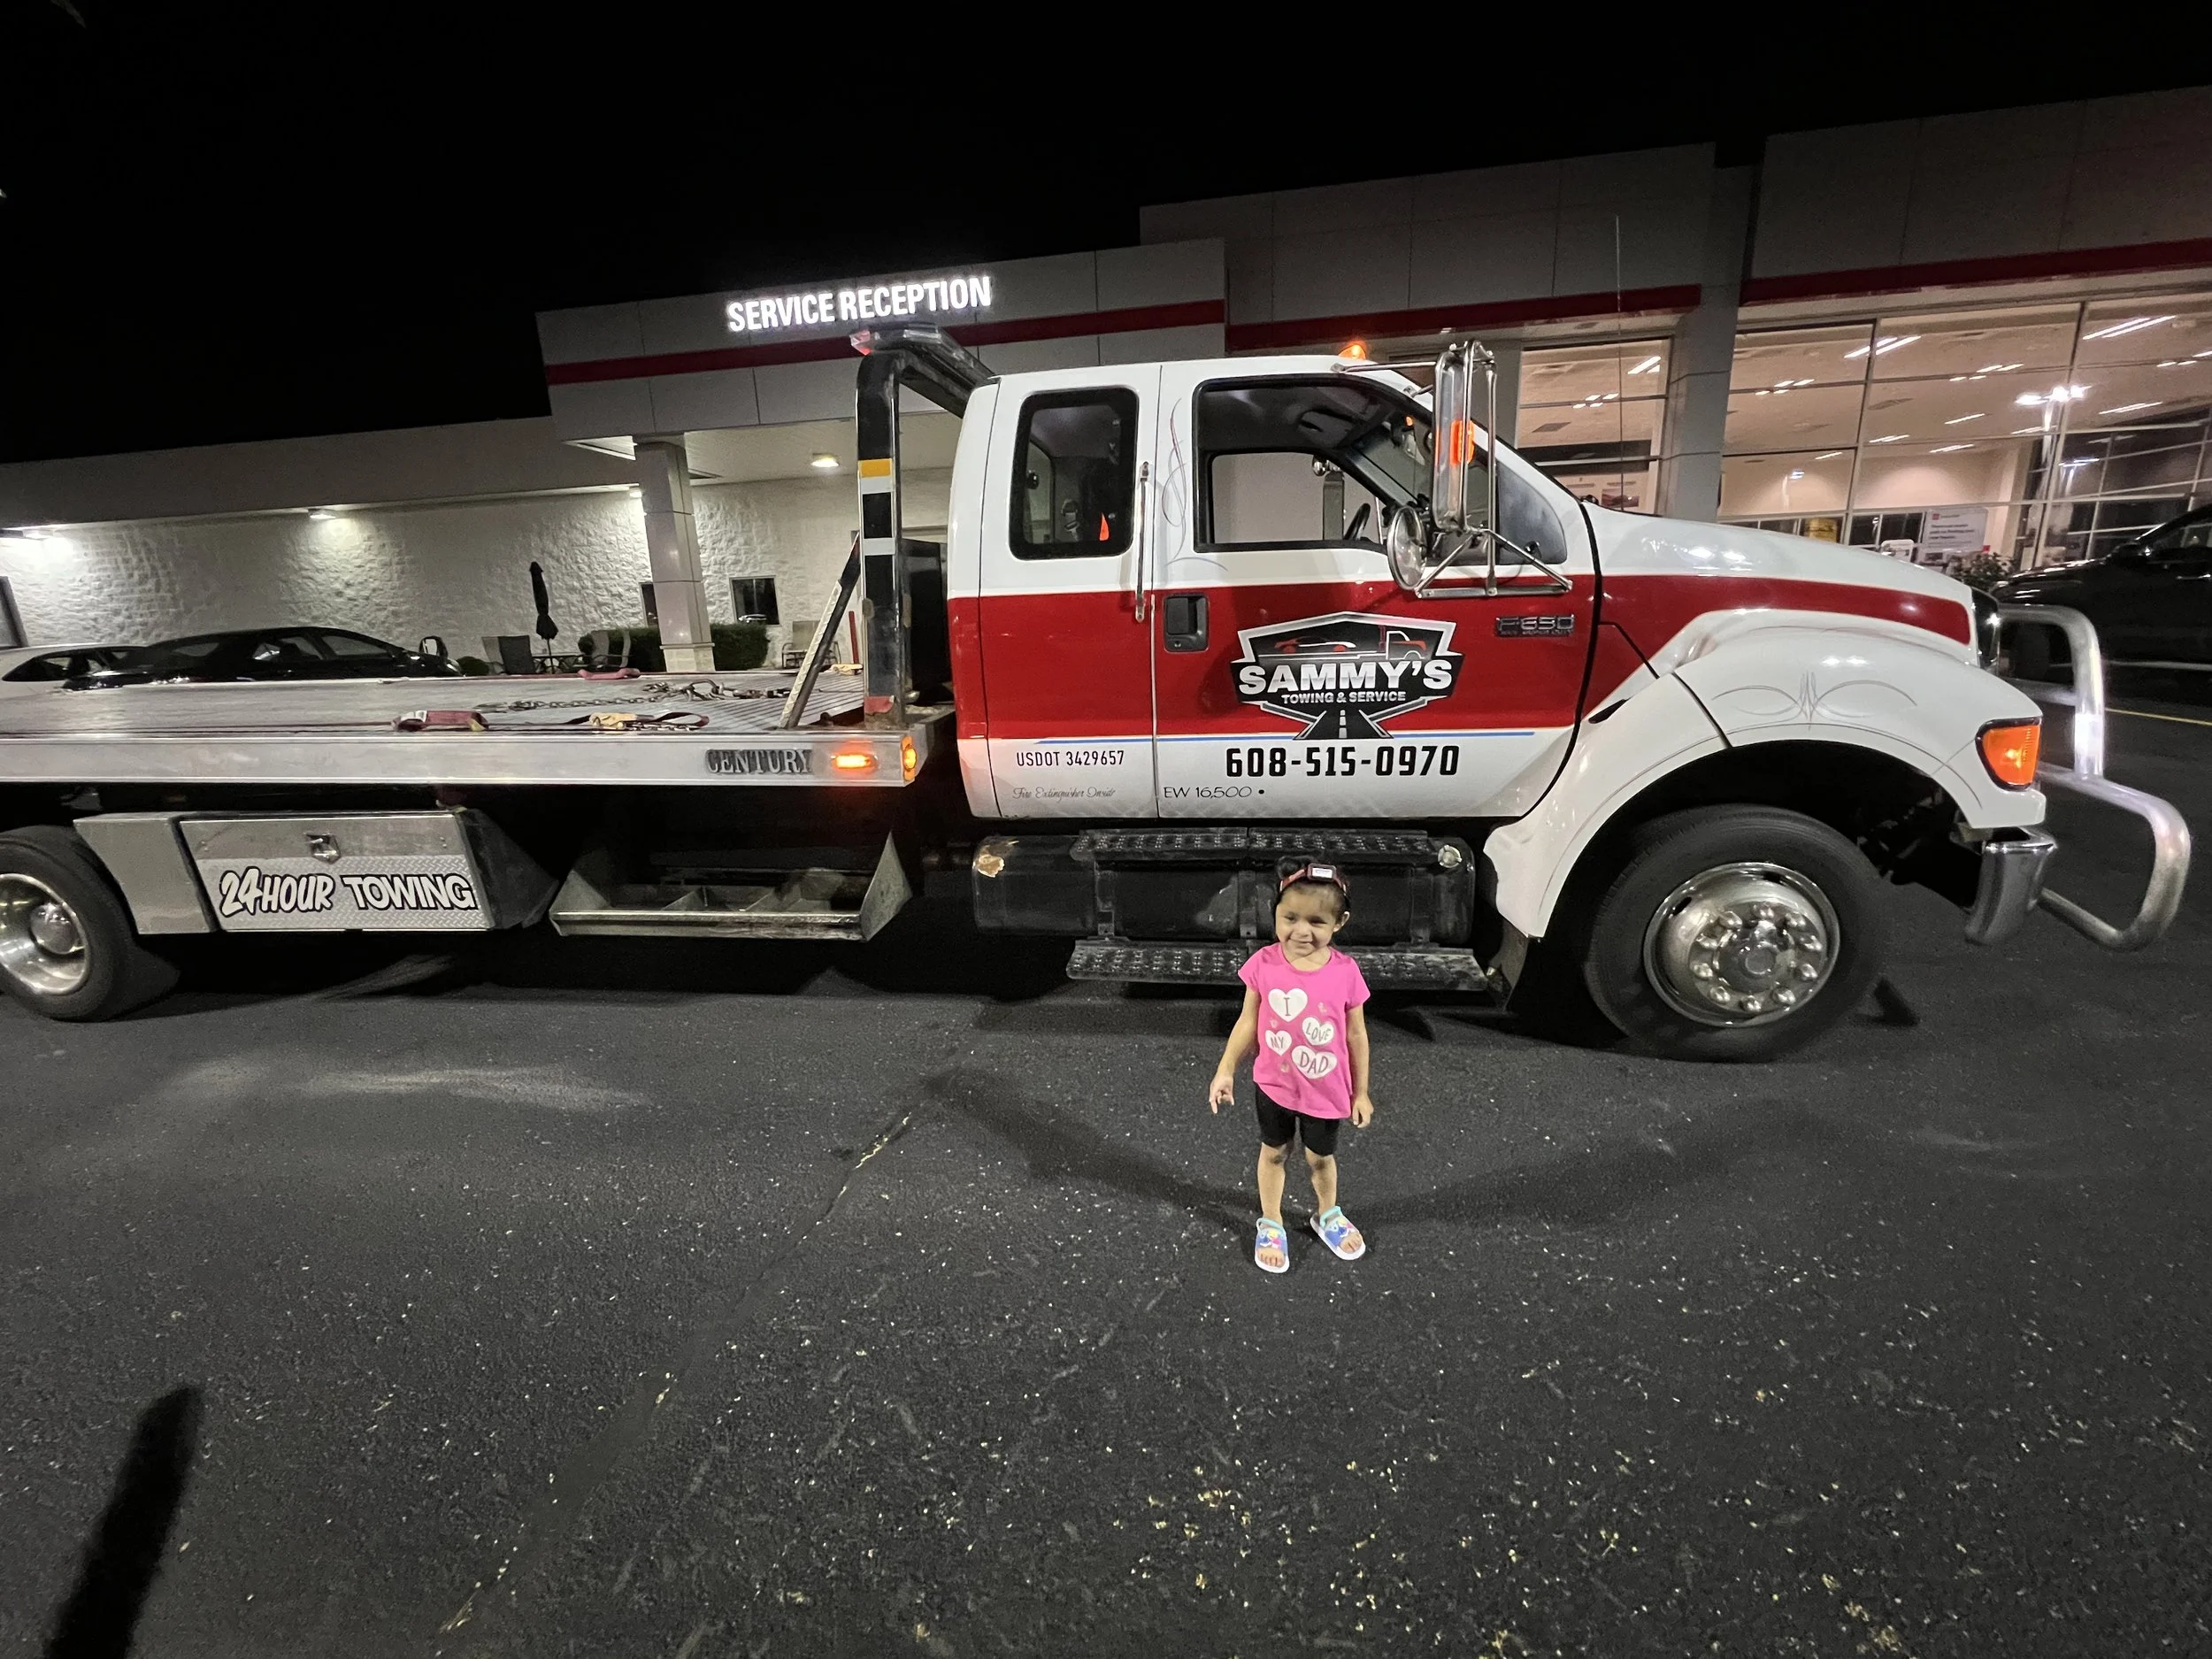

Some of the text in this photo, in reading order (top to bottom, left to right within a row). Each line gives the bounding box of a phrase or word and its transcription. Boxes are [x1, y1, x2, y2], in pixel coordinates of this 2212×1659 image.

[726, 276, 992, 332] SERVICE RECEPTION
[1239, 659, 1453, 695] SAMMY'S
[1281, 691, 1407, 704] TOWING & SERVICE
[707, 749, 810, 773] CENTURY
[1017, 750, 1125, 766] USDOT 3429657
[1226, 745, 1460, 777] 608-515-0970
[1164, 786, 1252, 799] EW 16,500
[341, 873, 479, 910] TOWING
[1284, 997, 1290, 1016] I
[1271, 1035, 1285, 1048] MY
[1306, 1022, 1331, 1041] LOVE
[1299, 1051, 1329, 1074] DAD
